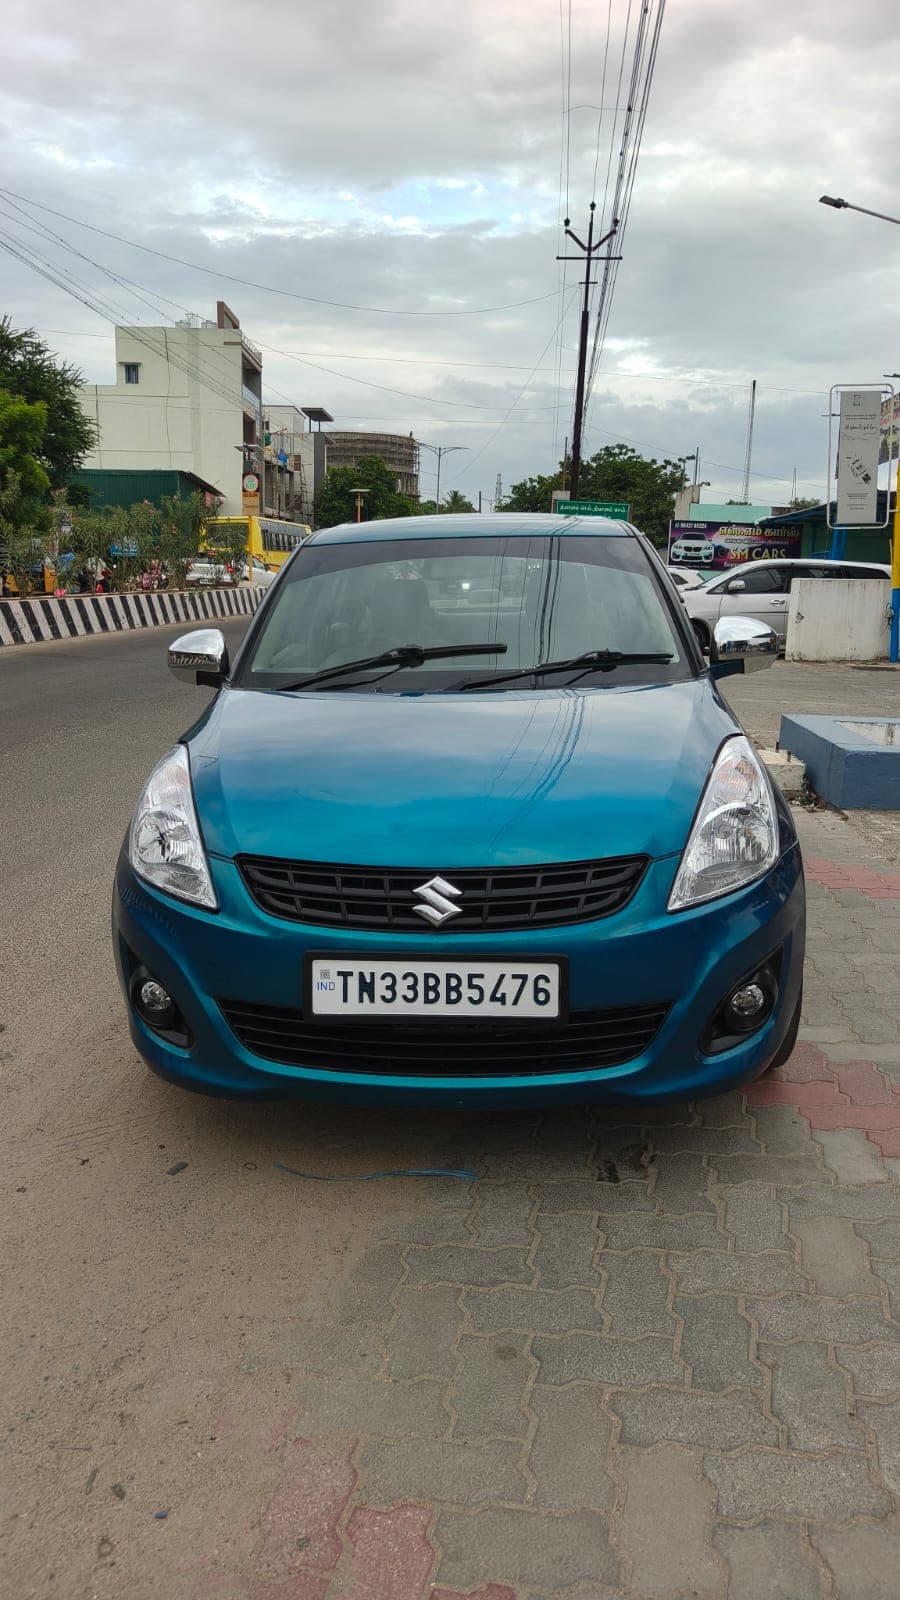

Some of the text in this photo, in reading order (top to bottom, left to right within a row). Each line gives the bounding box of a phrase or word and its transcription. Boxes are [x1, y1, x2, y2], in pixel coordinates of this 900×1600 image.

[730, 547, 786, 560] SM CARS
[316, 981, 336, 991] IND
[336, 971, 551, 1006] TN33BB5476
